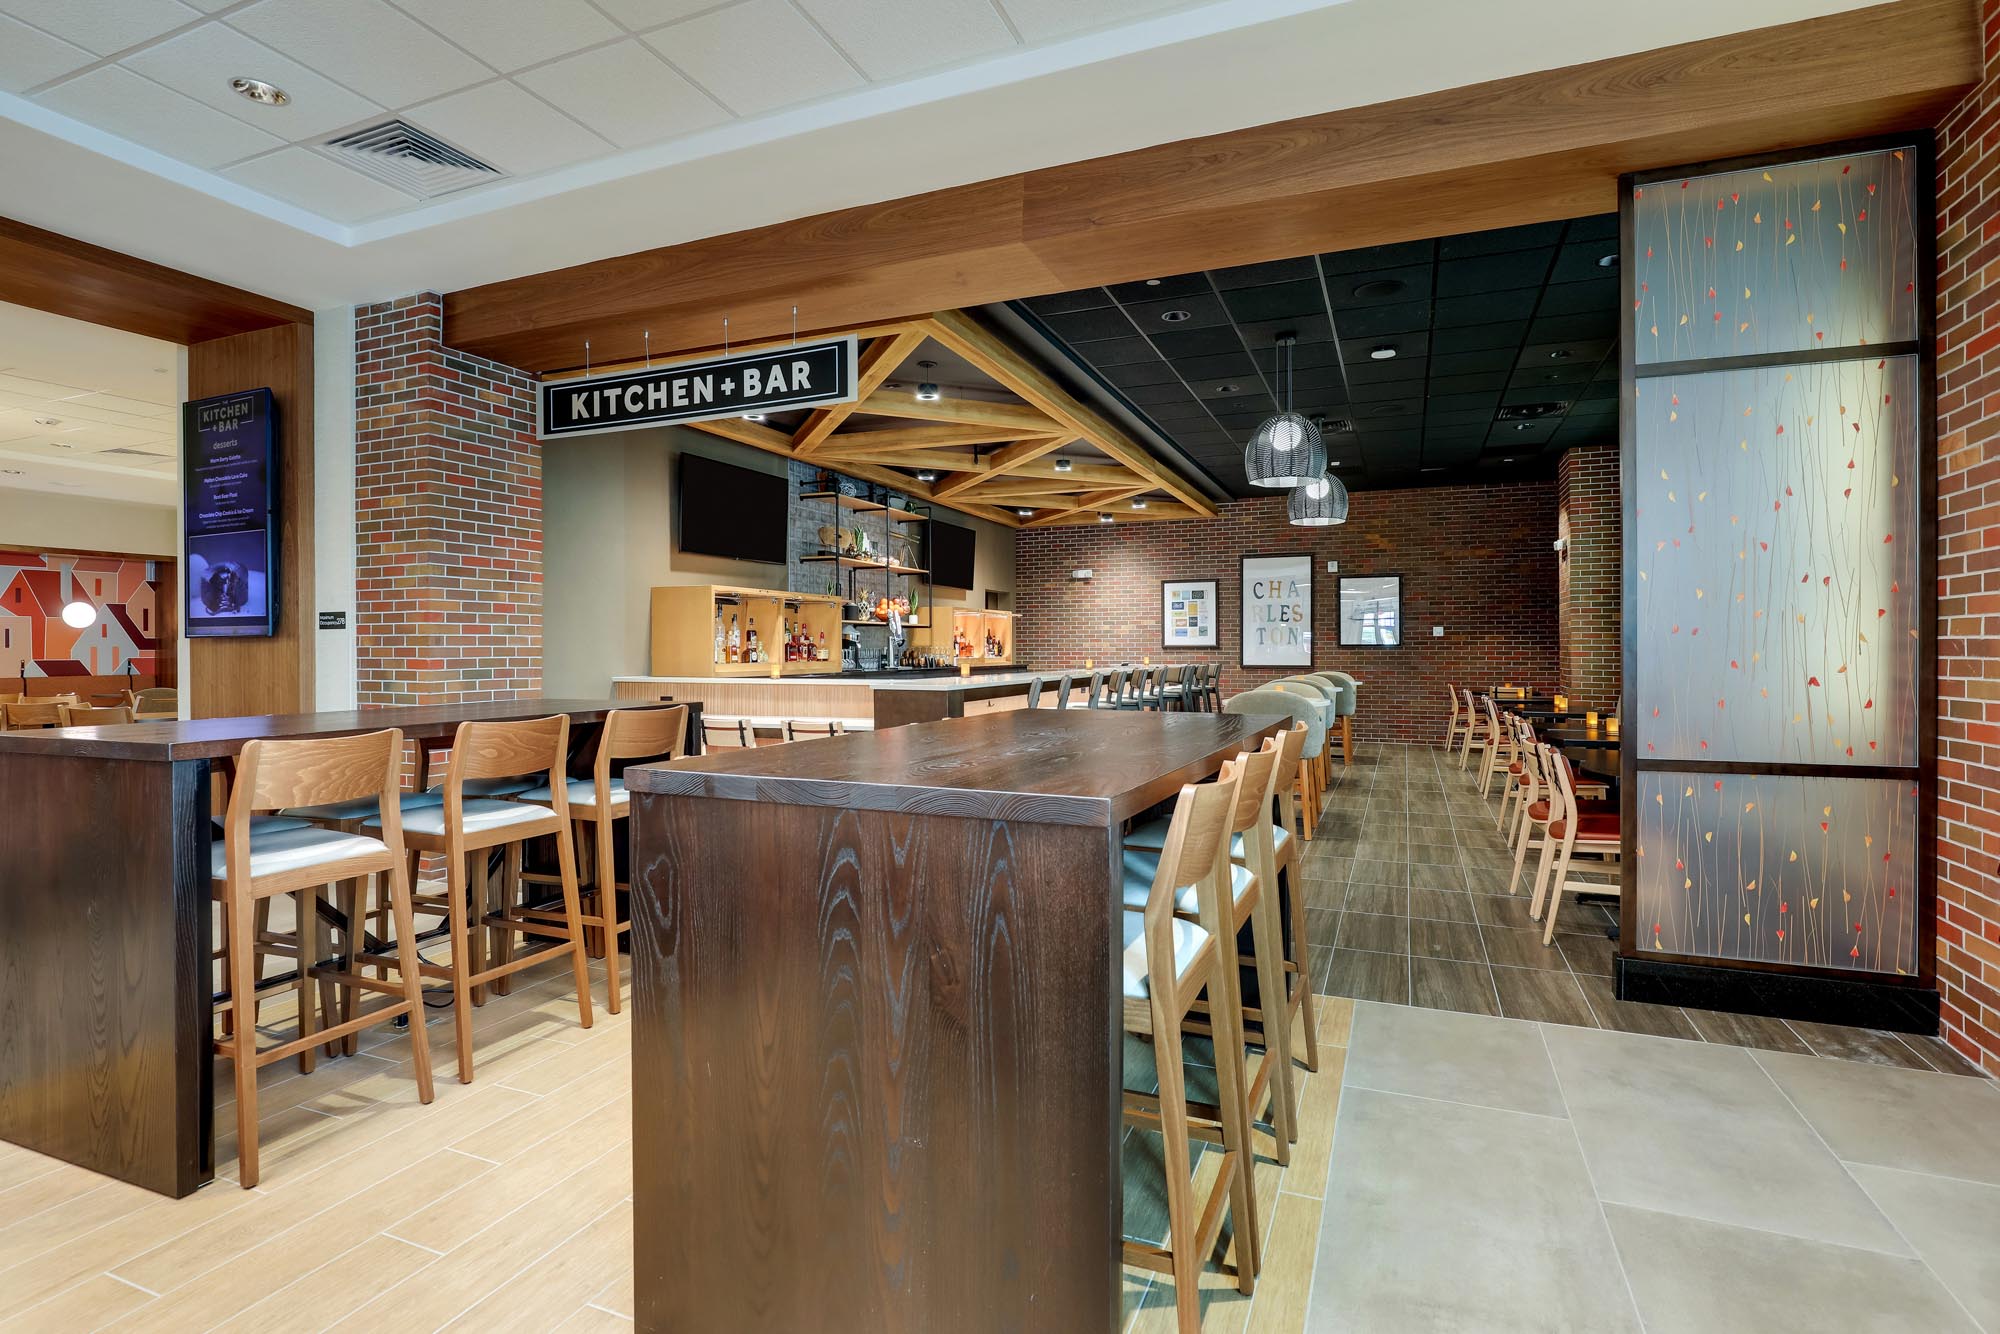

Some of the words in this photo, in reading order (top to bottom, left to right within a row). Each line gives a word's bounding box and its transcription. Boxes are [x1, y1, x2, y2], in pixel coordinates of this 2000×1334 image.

[571, 374, 714, 420] KITCHEN
[743, 360, 812, 398] BAR
[203, 402, 249, 423] KITCHEN
[218, 418, 239, 433] BAR
[212, 439, 238, 450] desserts
[1253, 580, 1300, 600] CHA
[1253, 604, 1303, 623] RLES
[1256, 626, 1299, 645] TON
